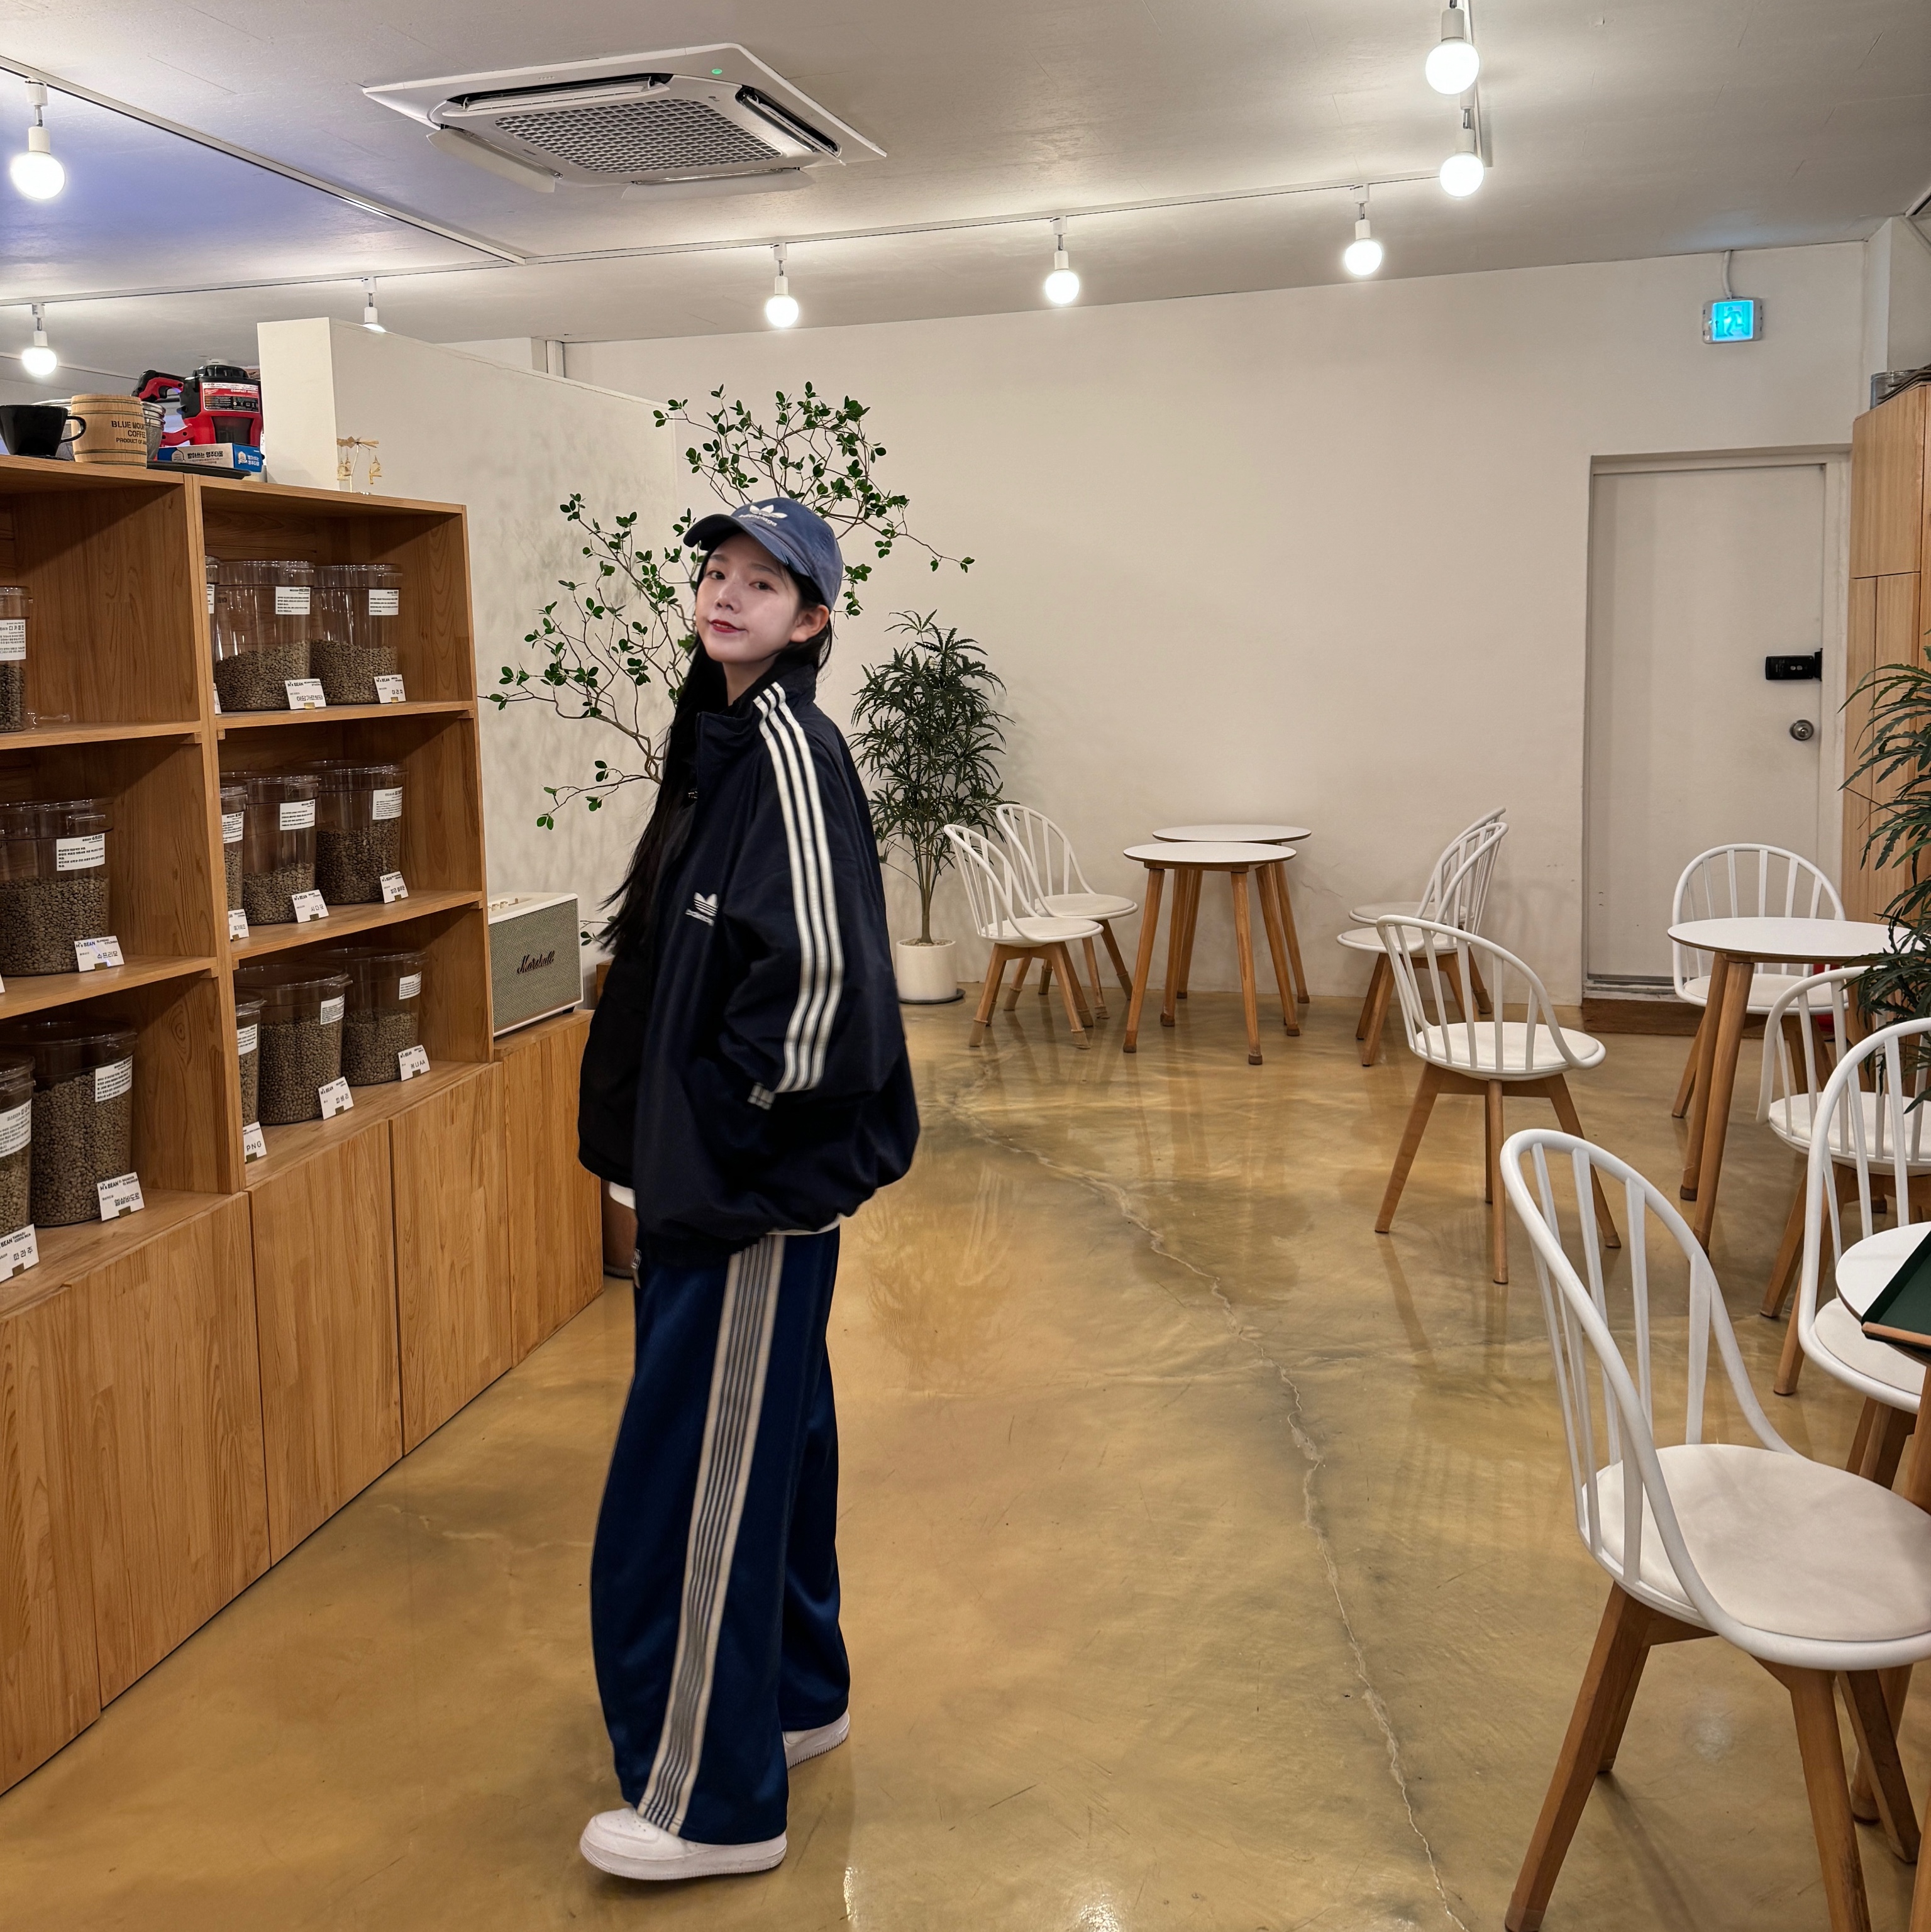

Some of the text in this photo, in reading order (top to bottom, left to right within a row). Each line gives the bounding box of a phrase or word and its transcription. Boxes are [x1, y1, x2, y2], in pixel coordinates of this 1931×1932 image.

[97, 951, 118, 959] 슈프리모
[517, 950, 555, 974] Marshall
[246, 1140, 262, 1152] PNG
[108, 1180, 119, 1189] BEAN
[114, 1192, 140, 1206] 엘살바도르
[1, 1237, 13, 1247] BEAN
